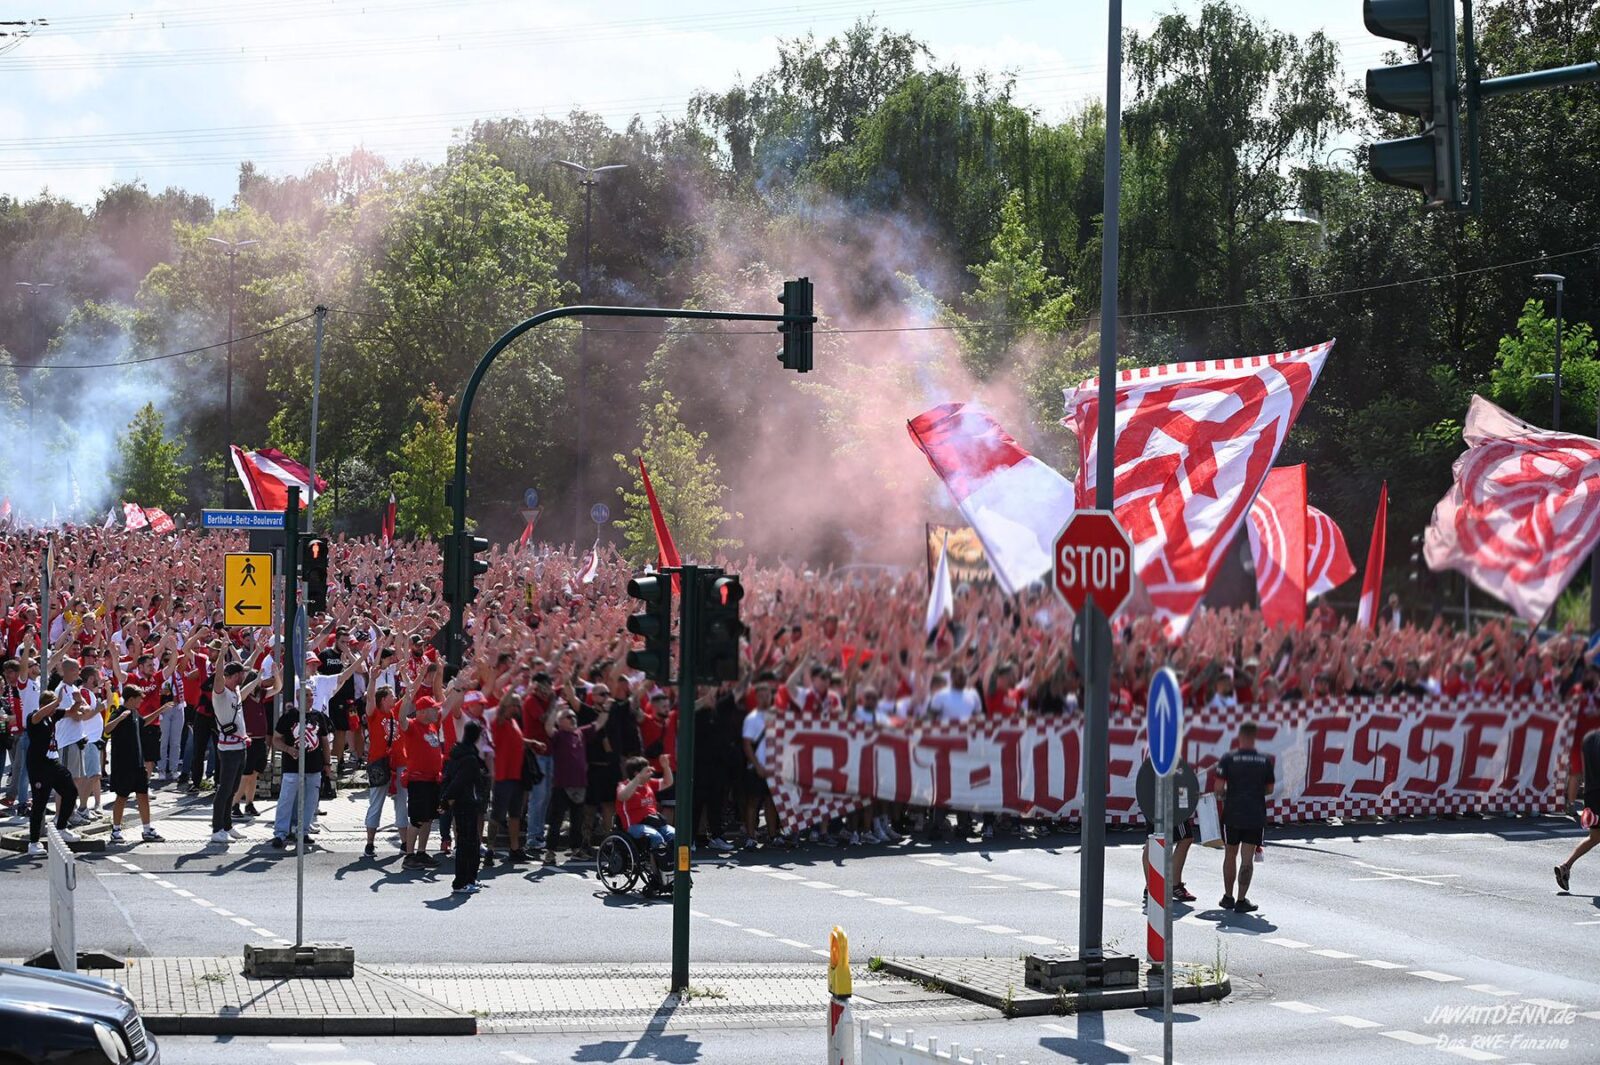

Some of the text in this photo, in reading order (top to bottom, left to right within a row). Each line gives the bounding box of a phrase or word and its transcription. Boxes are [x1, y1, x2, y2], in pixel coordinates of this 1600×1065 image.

[207, 515, 283, 526] Berthold-Beitz-Boulevard
[1061, 545, 1126, 590] STOP
[790, 713, 1559, 817] ROT-WES ESSEN
